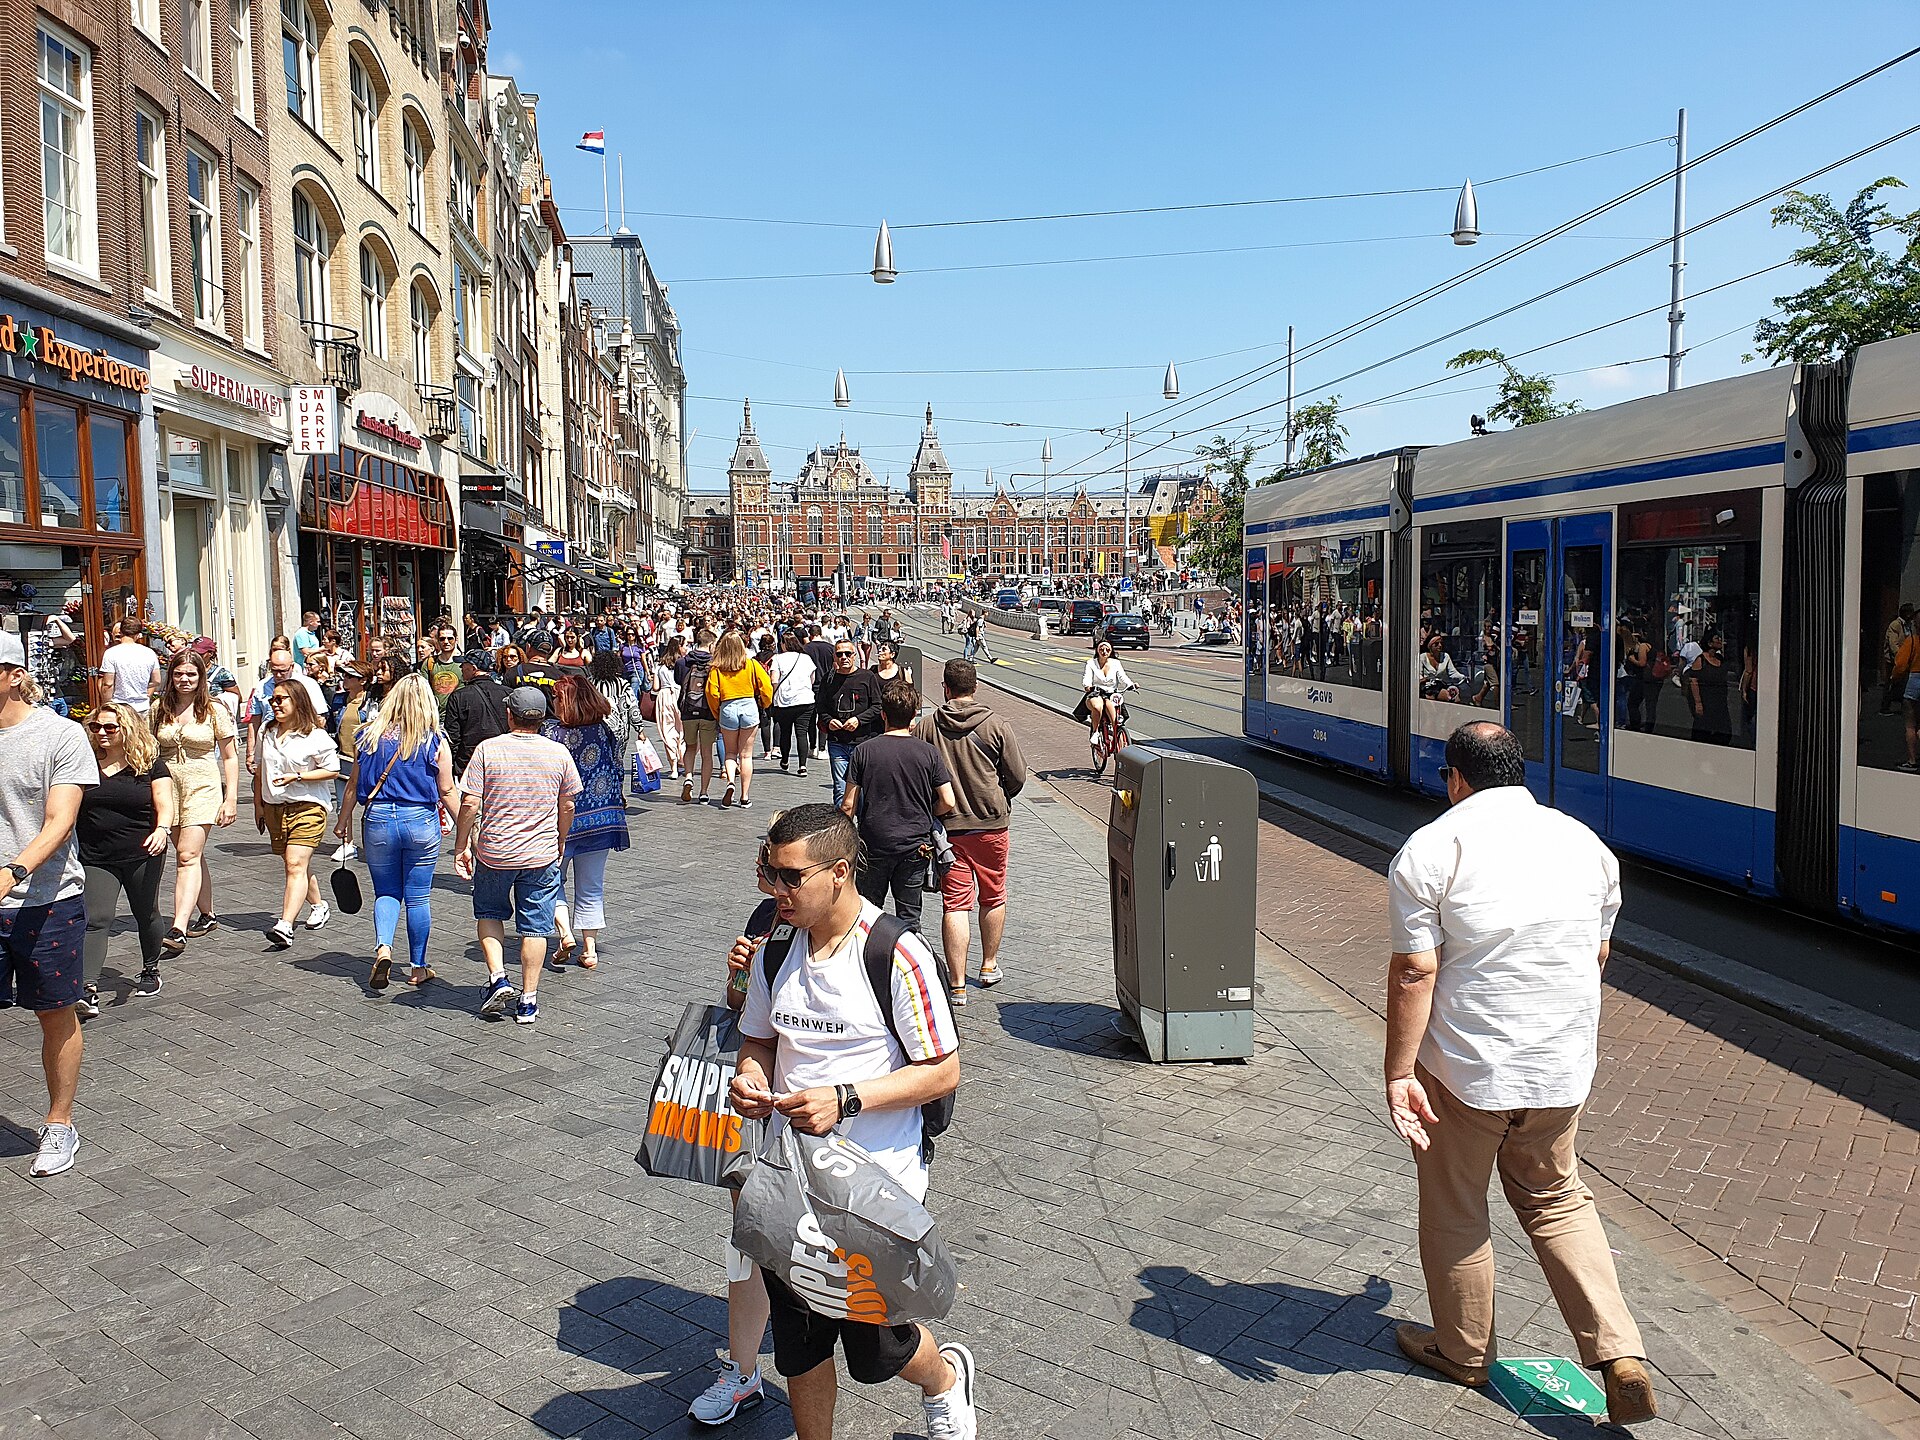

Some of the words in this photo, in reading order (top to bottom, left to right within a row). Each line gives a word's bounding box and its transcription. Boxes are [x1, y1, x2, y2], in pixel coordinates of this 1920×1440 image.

[41, 326, 150, 394] Experience
[191, 364, 283, 417] SUPERMARKET
[299, 389, 310, 451] SUPER
[313, 389, 326, 451] MARKT
[1319, 690, 1333, 704] GVB
[1312, 728, 1327, 742] 2084
[775, 1011, 844, 1034] FERNWEH
[654, 1054, 743, 1119] SNIPE
[648, 1100, 743, 1153] KNOWS
